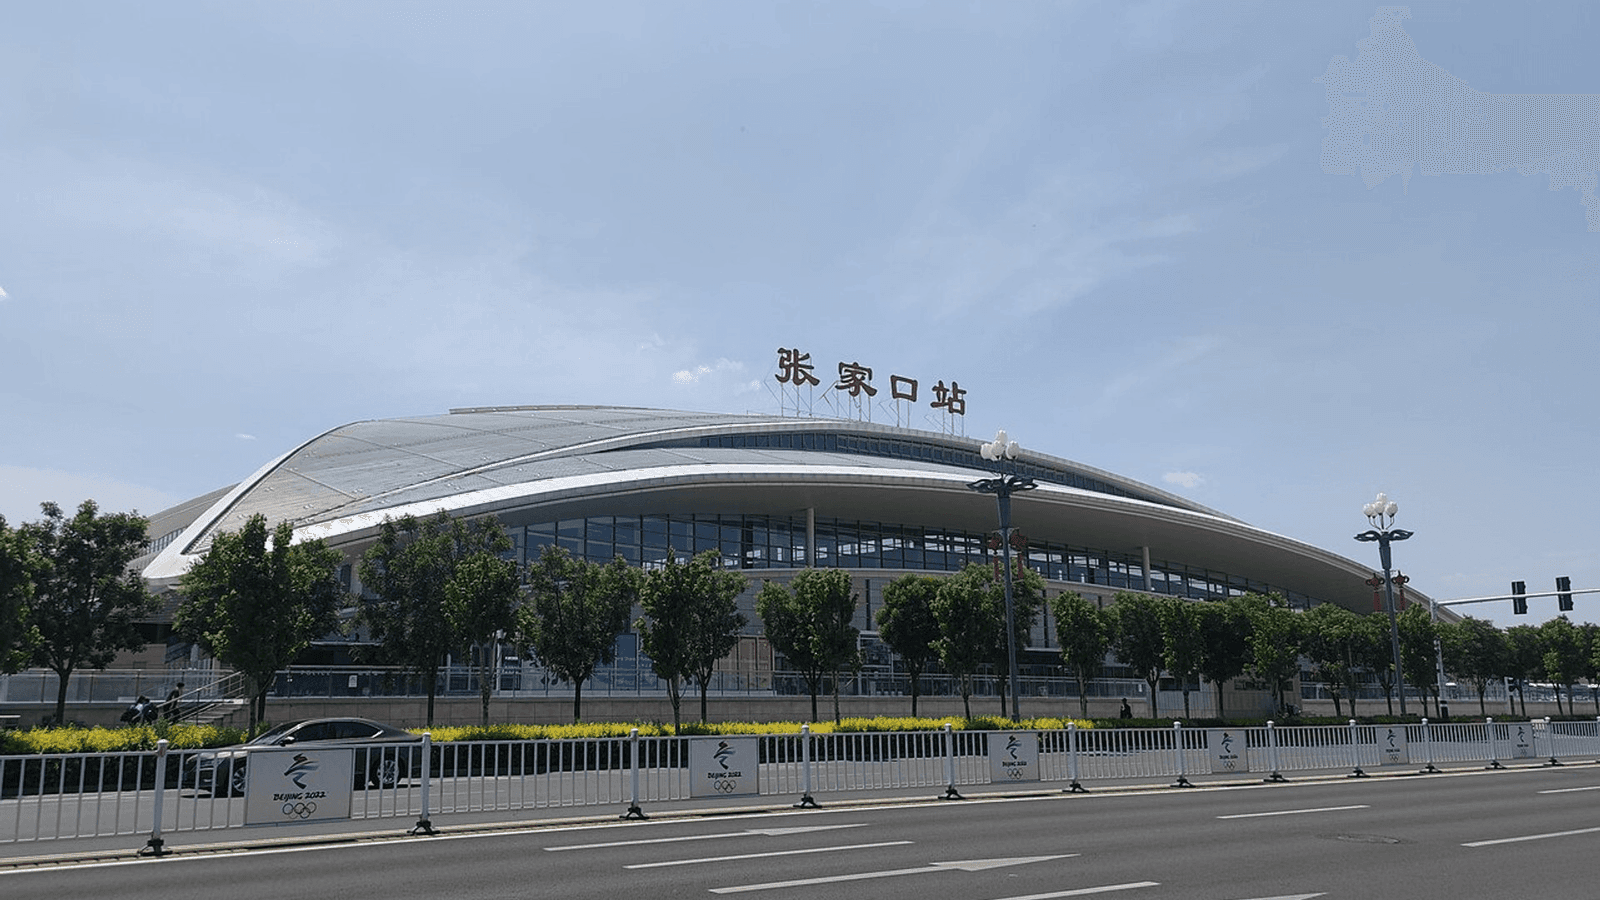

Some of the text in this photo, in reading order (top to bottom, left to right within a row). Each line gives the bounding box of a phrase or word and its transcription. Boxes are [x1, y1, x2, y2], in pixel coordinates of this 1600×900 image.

[775, 347, 967, 416] 张家口站
[273, 791, 326, 802] BEIJING 2022
